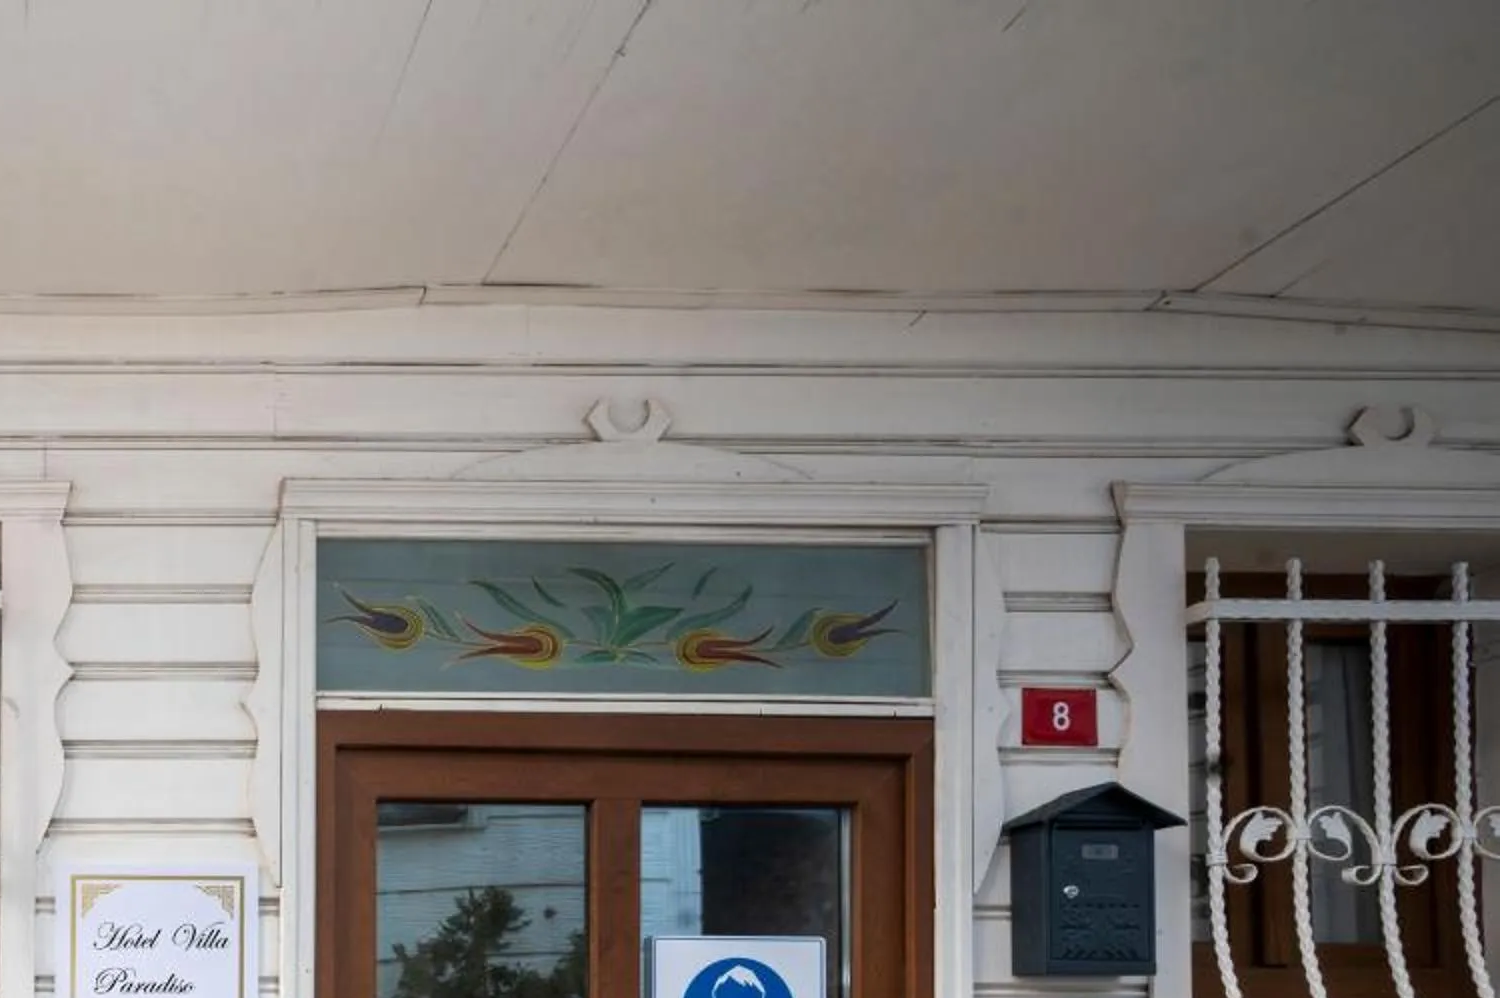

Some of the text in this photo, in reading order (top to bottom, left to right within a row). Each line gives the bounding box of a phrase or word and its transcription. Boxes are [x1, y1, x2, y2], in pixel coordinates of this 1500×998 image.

[1052, 701, 1071, 731] 8
[92, 921, 229, 951] Hotel Villa
[93, 967, 196, 994] Paradiso
